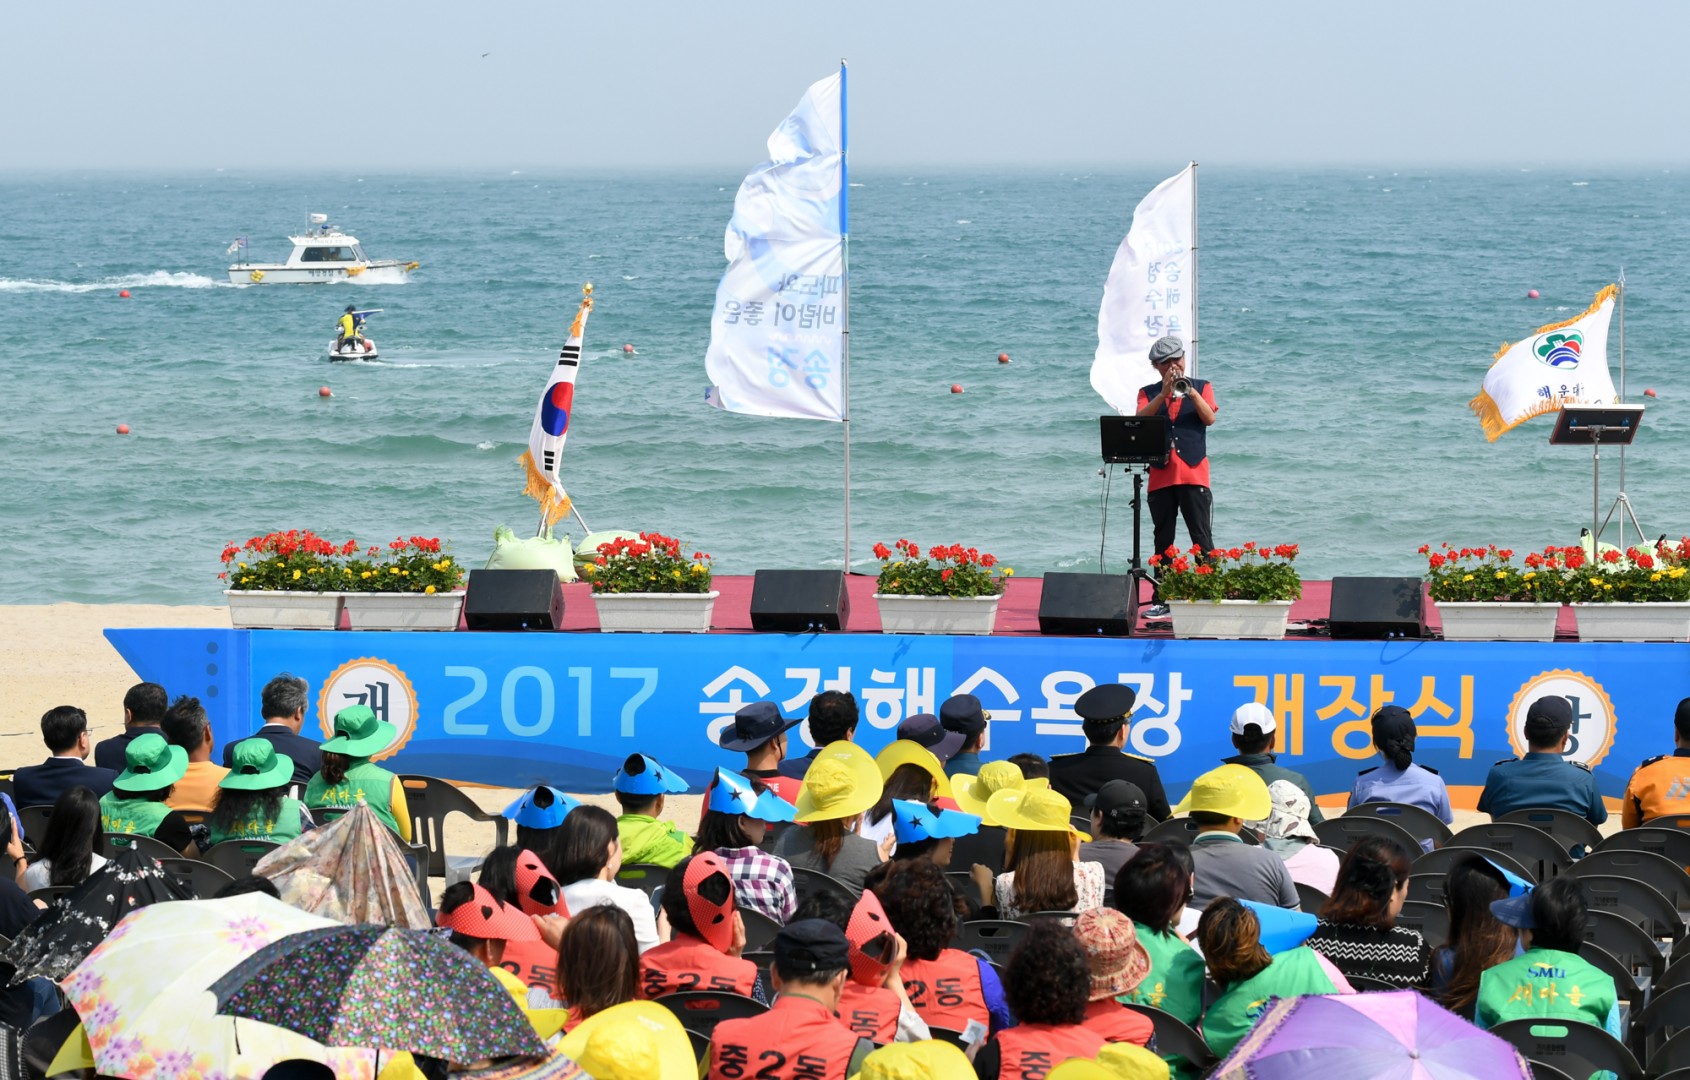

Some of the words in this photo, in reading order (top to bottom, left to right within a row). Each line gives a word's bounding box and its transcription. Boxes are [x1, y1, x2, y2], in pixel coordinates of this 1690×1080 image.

[443, 665, 659, 737] 2017
[1233, 673, 1475, 760] 개장식
[1527, 967, 1566, 979] SMU
[1507, 982, 1586, 1007] 새마을
